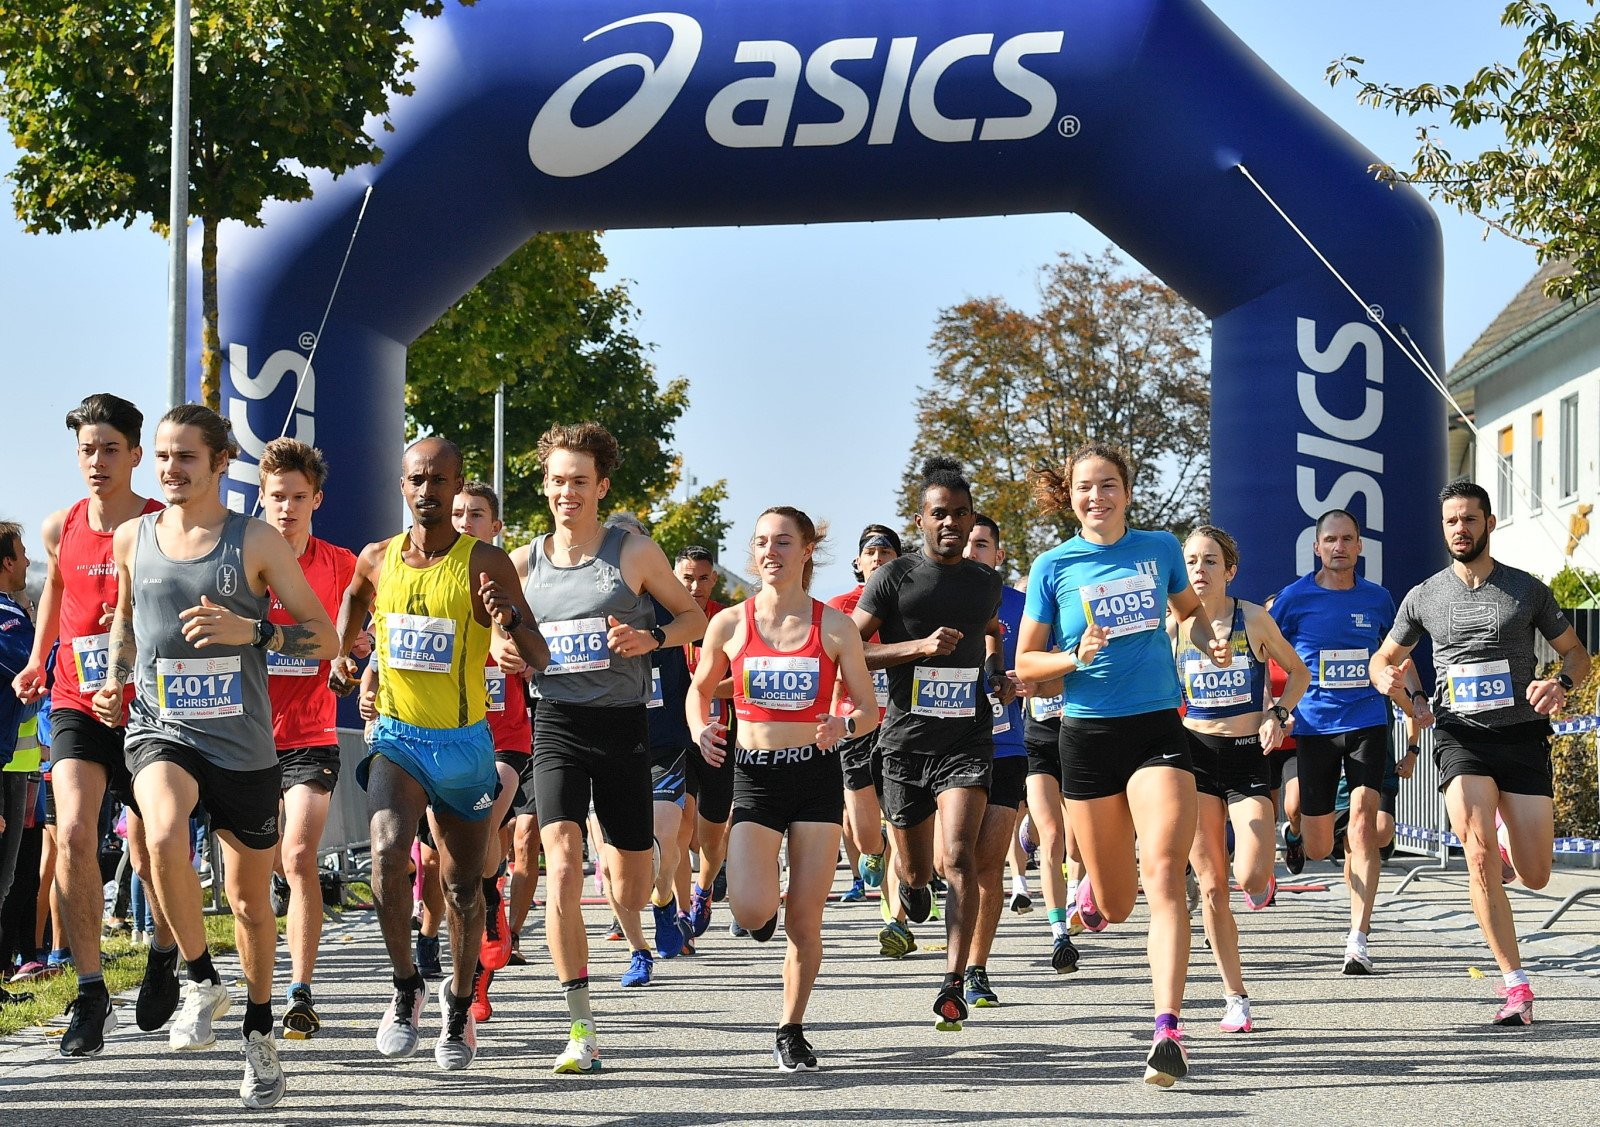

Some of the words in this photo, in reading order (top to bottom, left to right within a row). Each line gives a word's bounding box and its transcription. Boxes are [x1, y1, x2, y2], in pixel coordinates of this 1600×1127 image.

[1095, 591, 1155, 617] 4095
[1116, 612, 1145, 625] DELIA
[391, 629, 447, 652] 4070
[549, 634, 602, 654] 4016
[275, 658, 306, 666] JULIAN
[399, 650, 435, 661] TEFERA
[564, 653, 589, 663] NOAH
[1325, 664, 1366, 678] 4126
[168, 674, 234, 696] 4017
[752, 672, 813, 691] 4103
[1193, 671, 1246, 690] 4048
[761, 691, 807, 700] JOCELINE
[921, 682, 971, 699] 4071
[1206, 689, 1237, 698] NICOLE
[1455, 680, 1506, 698] 4139
[176, 696, 231, 708] CHRISTIAN
[934, 700, 963, 708] KIFLAY
[1235, 736, 1257, 746] NIKE
[735, 748, 770, 765] NIKE
[773, 745, 813, 765] PRO
